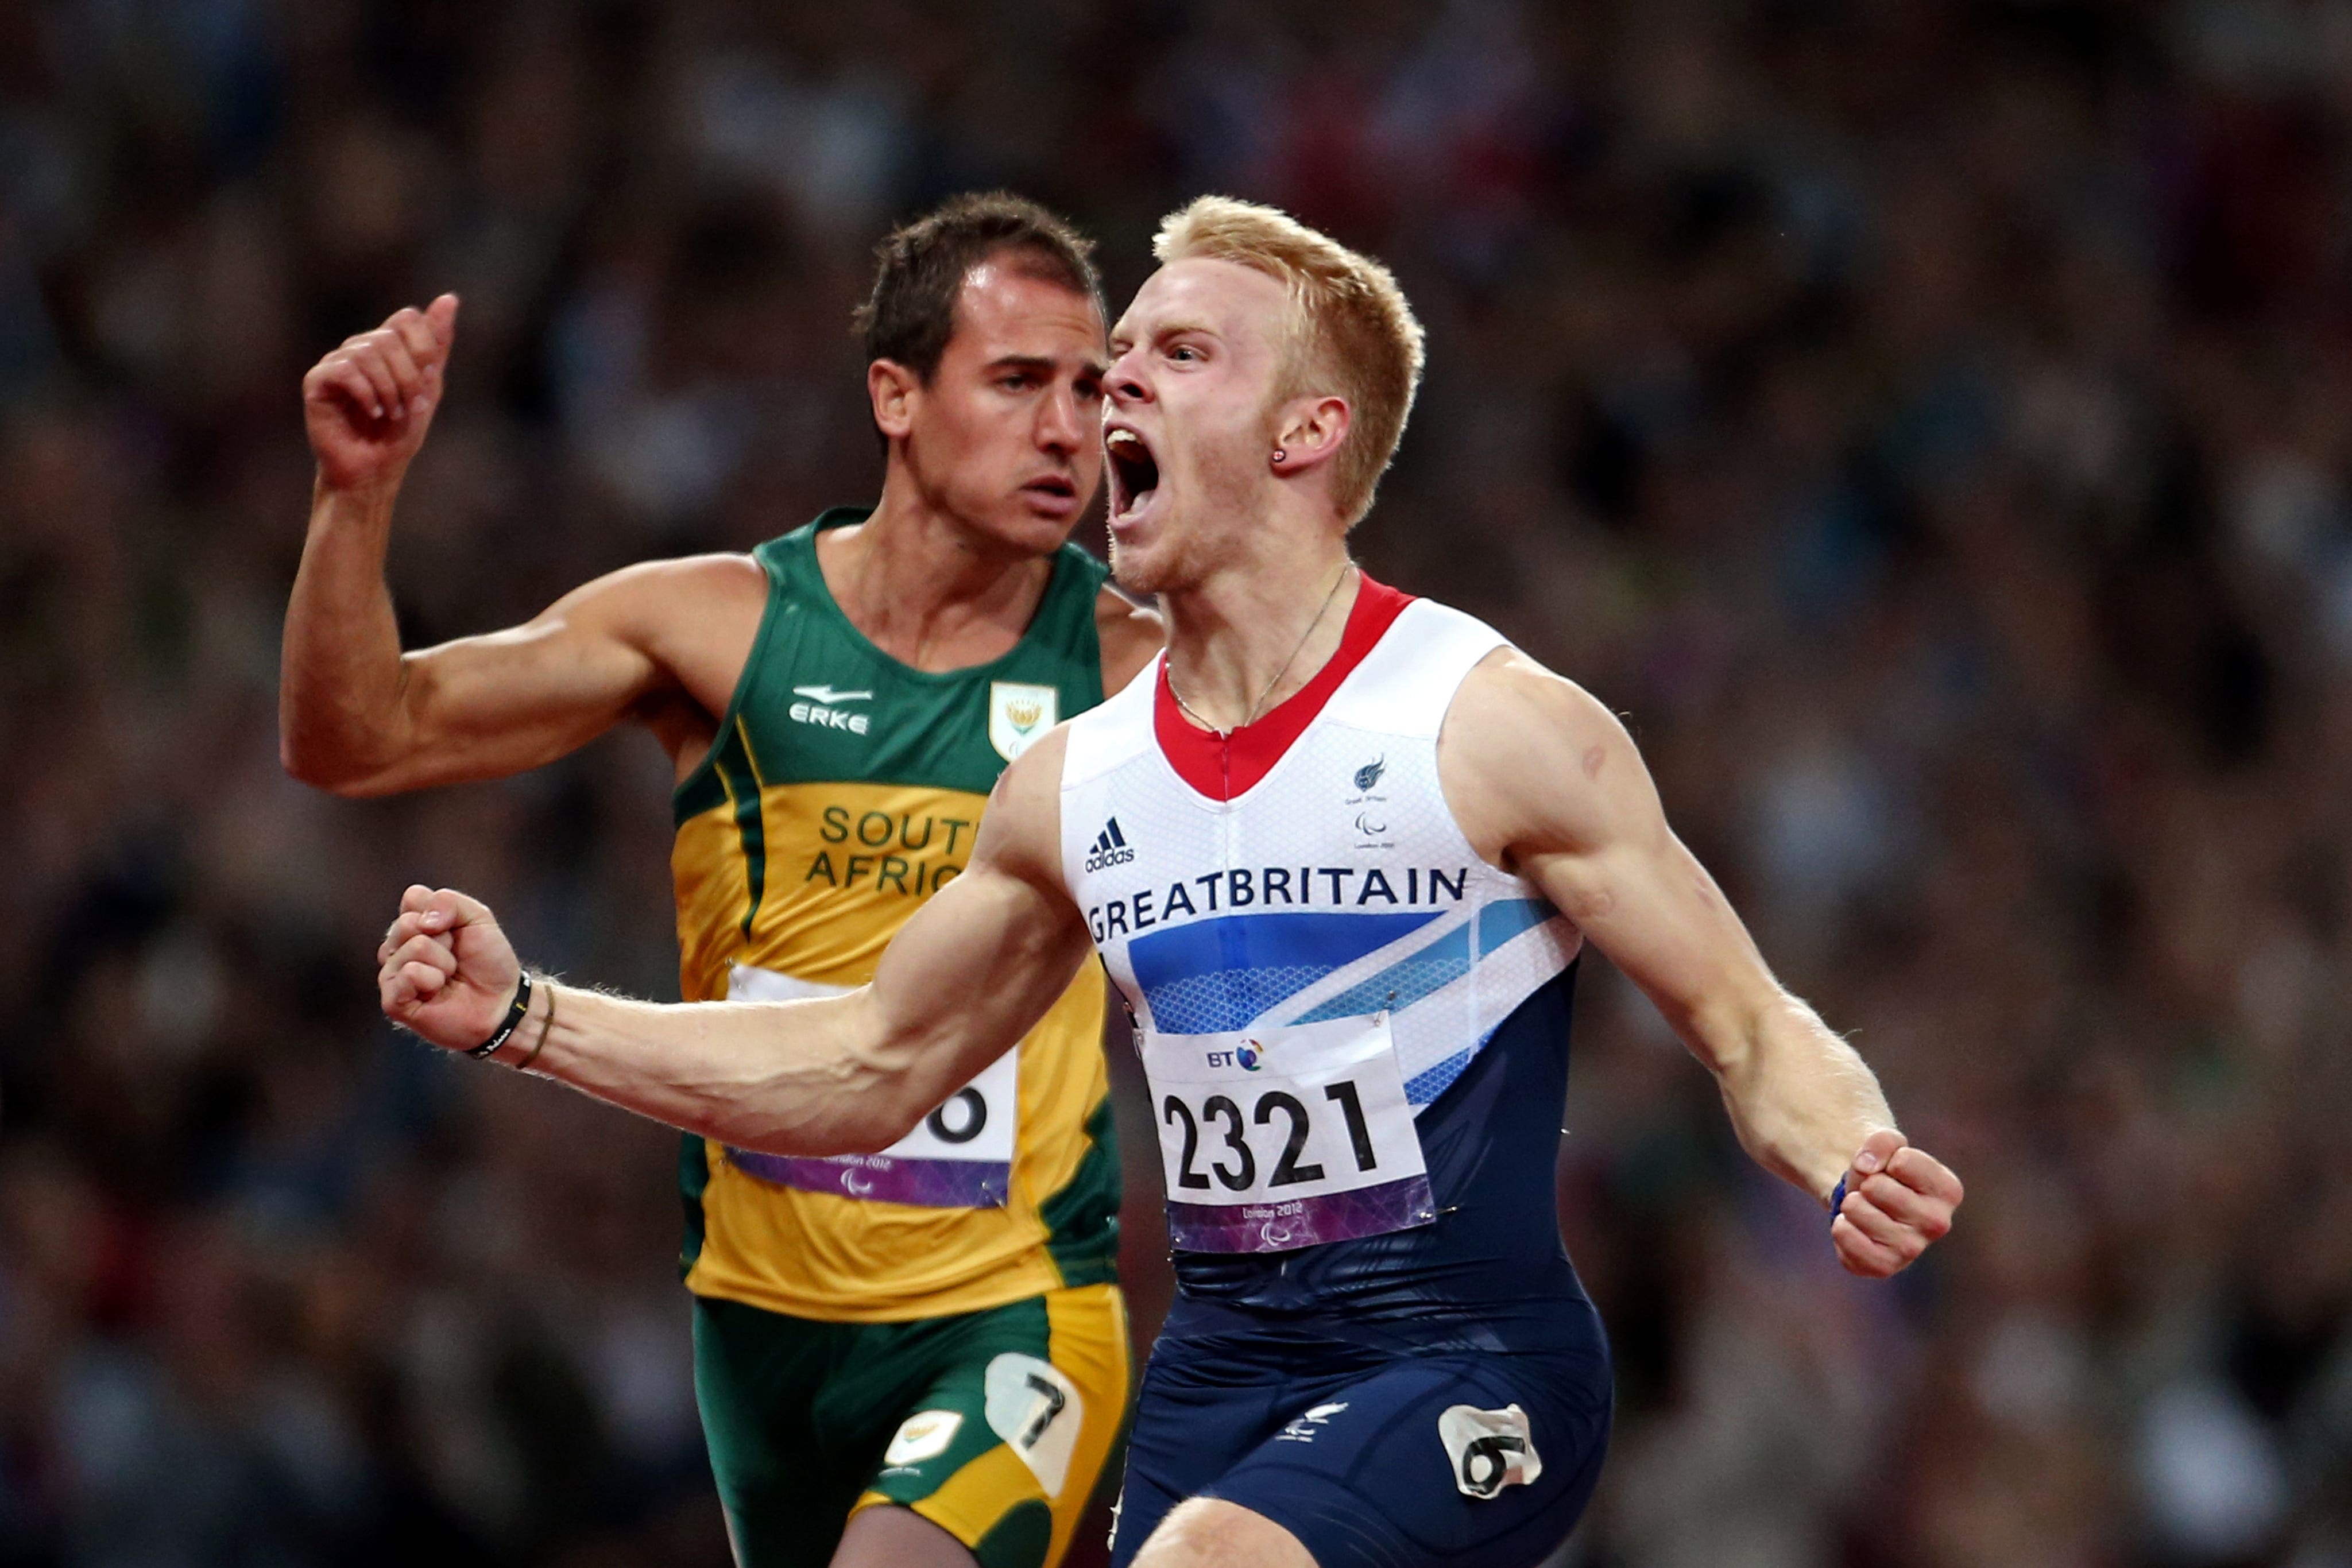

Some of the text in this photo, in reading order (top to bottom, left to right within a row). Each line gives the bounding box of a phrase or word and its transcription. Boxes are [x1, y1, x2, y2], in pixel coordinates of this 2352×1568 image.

[789, 703, 869, 735] ERKE
[1085, 847, 1135, 873] adidas
[1208, 1051, 1235, 1068] BT
[1164, 1080, 1377, 1191] 2321
[1276, 1202, 1303, 1217] 2012
[1020, 1372, 1066, 1450] 7
[1463, 1436, 1525, 1495] 6
